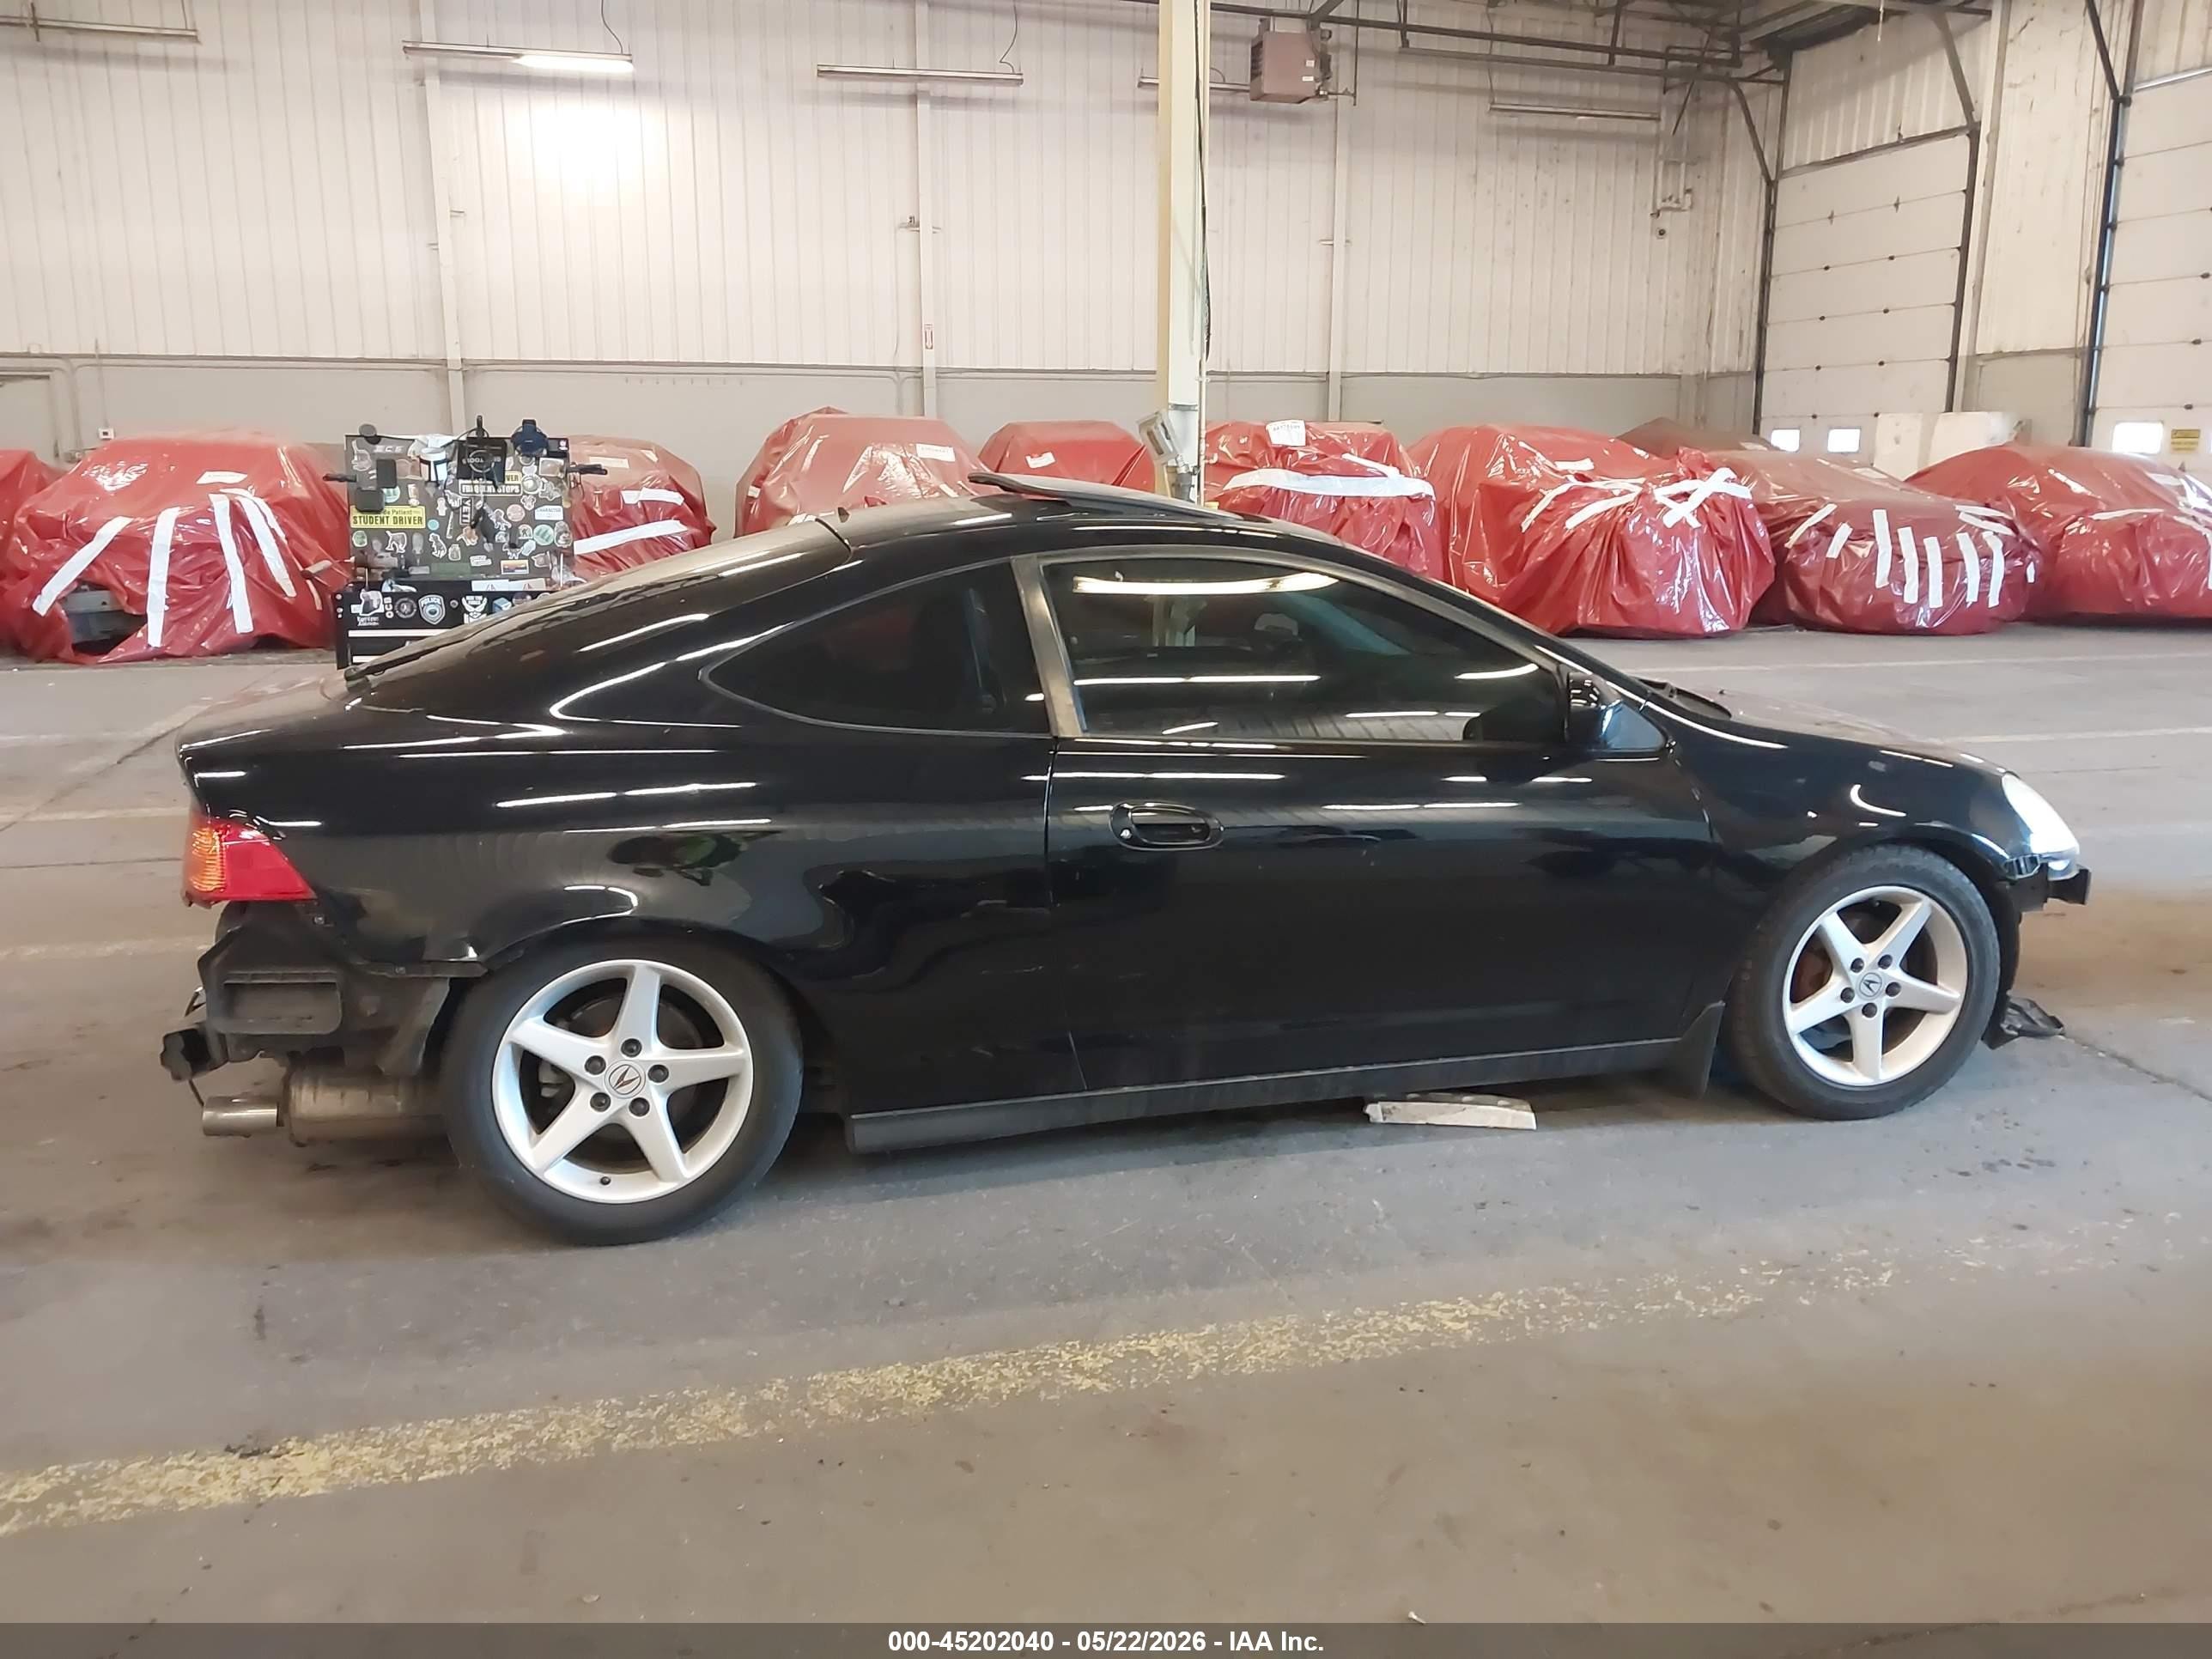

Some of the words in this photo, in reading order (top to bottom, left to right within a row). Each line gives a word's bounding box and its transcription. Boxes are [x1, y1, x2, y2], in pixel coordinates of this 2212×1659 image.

[462, 499, 471, 523] YETI
[353, 515, 391, 526] STUDENT
[392, 516, 423, 526] DRIVER
